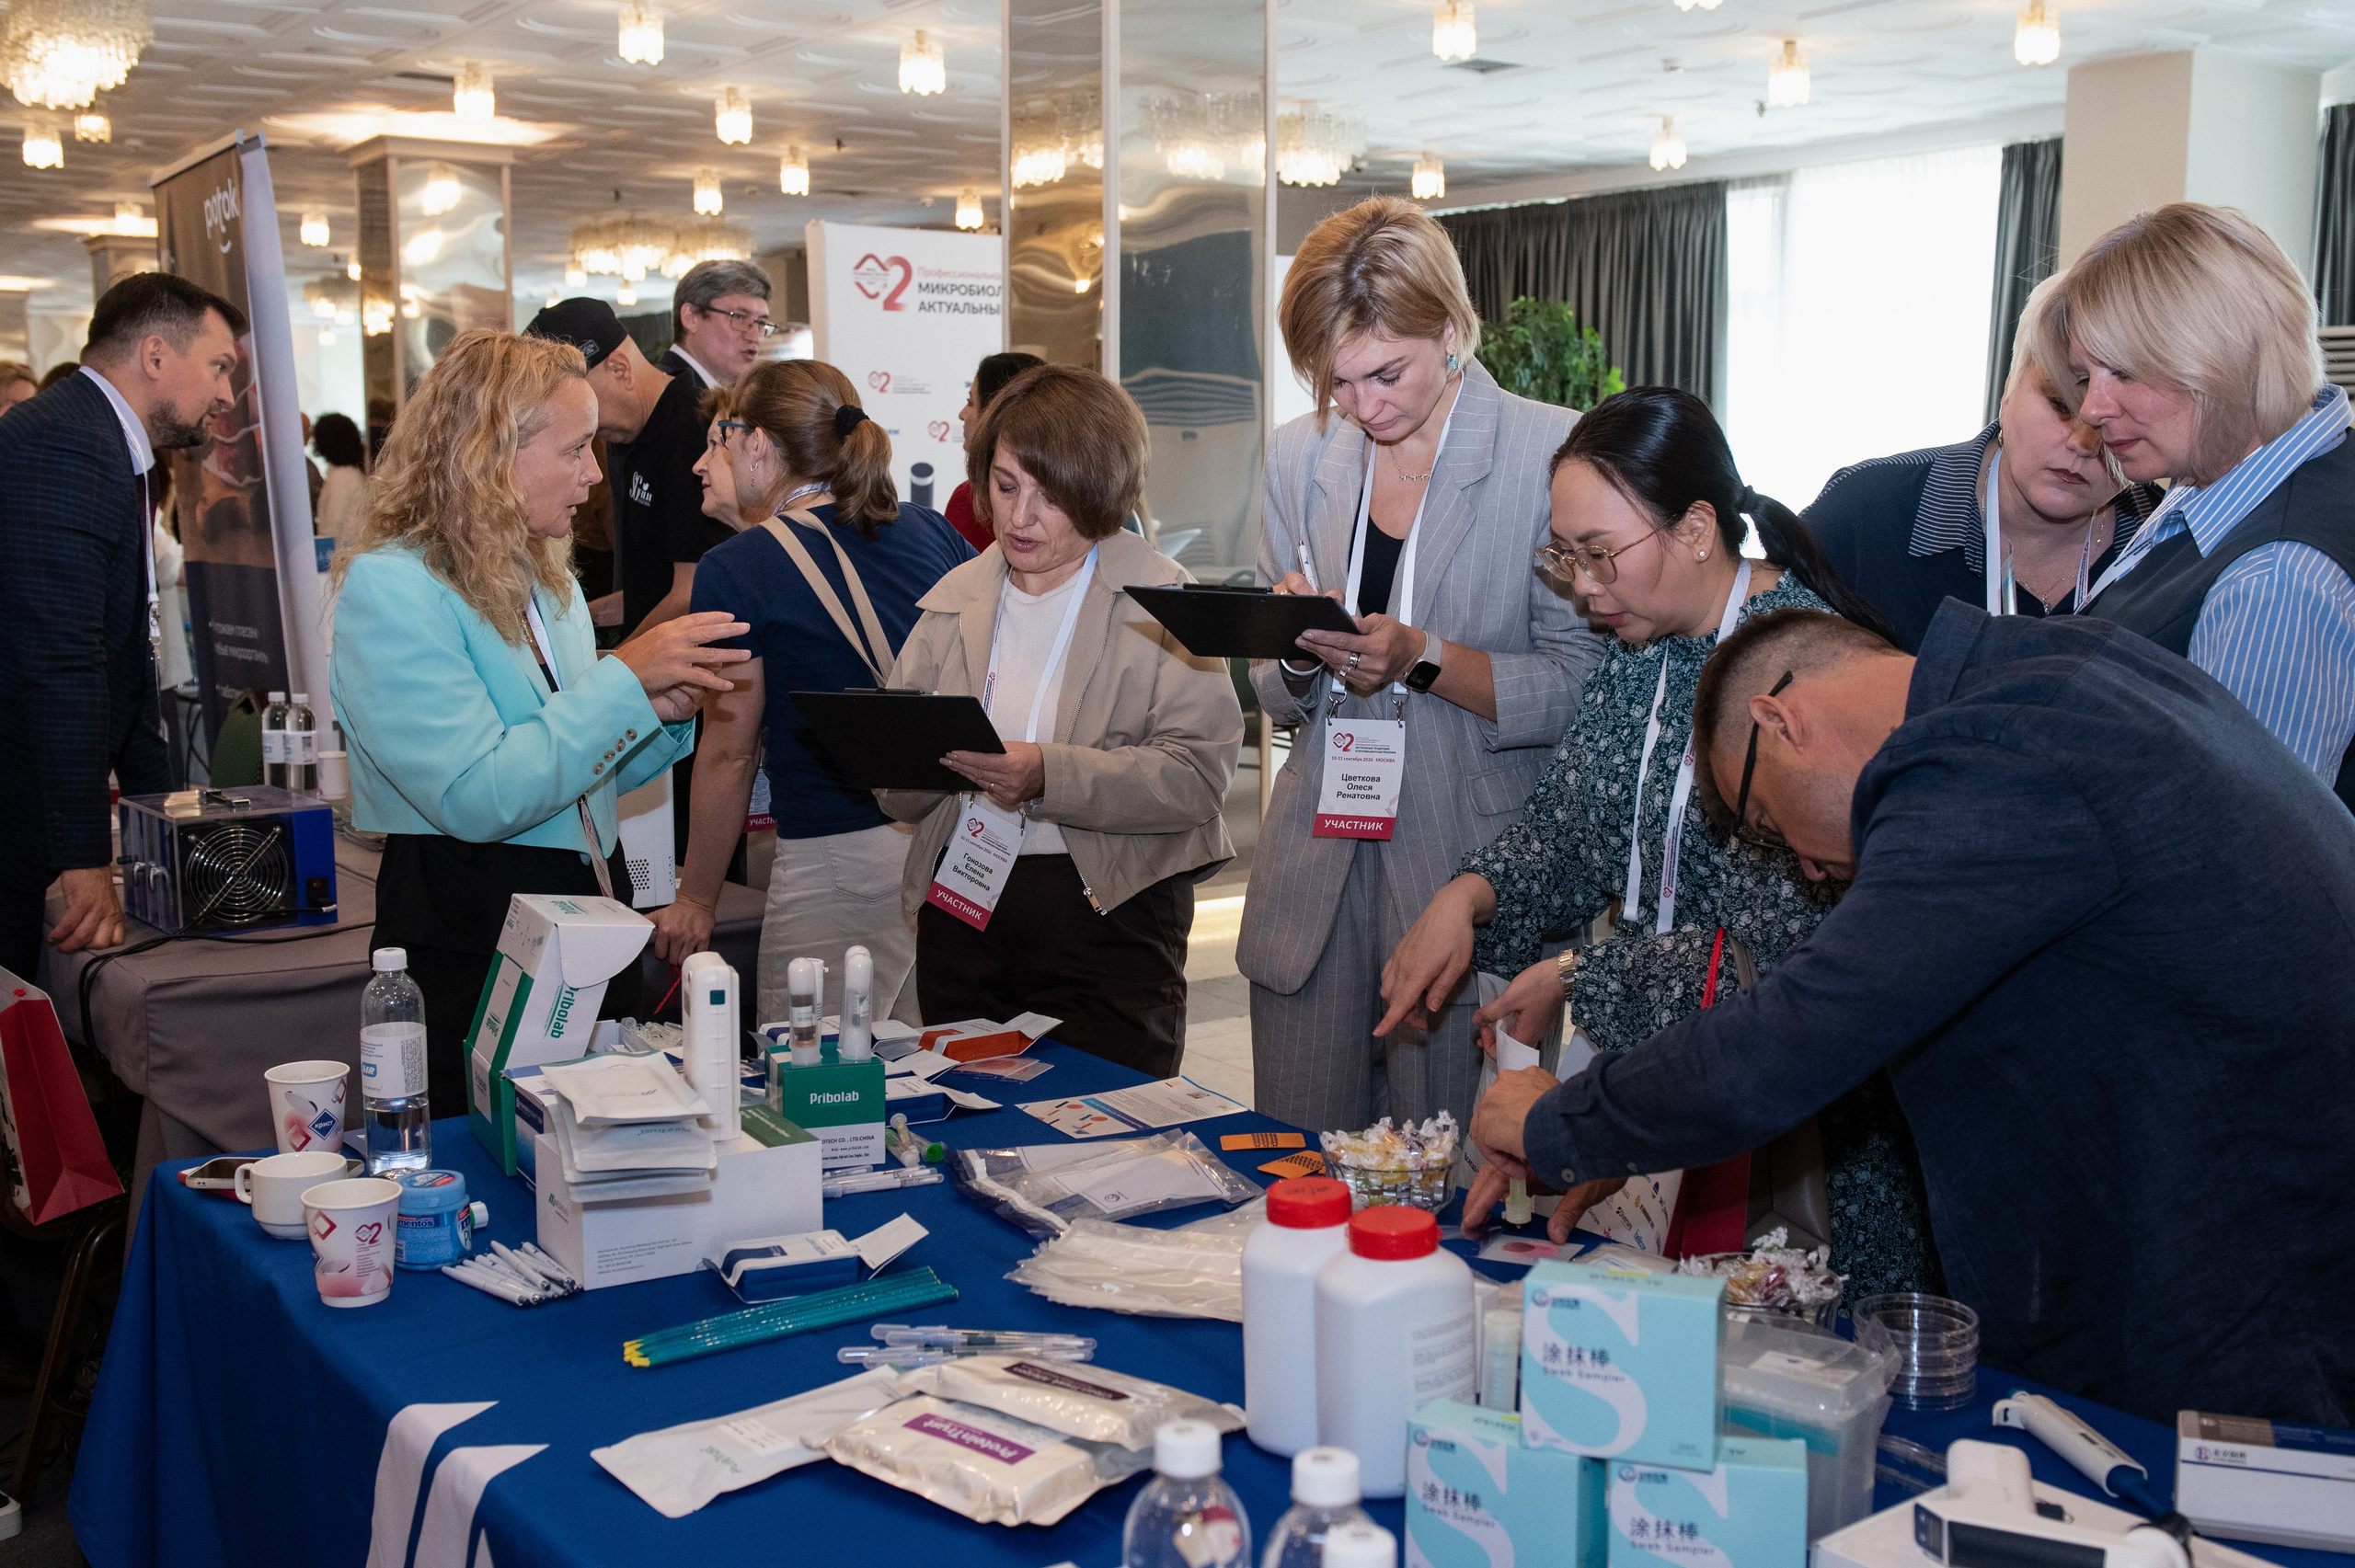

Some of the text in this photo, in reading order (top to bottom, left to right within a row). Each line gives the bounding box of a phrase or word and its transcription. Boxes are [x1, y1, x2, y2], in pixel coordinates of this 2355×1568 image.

[203, 177, 239, 239] potok
[1341, 773, 1381, 783] Цветкова
[1347, 783, 1373, 791] Олеся
[1336, 791, 1381, 800] Ренатовна
[749, 817, 777, 826] УЧАСТН
[1324, 818, 1384, 830] УЧАСТНИК
[964, 863, 985, 878] Елена
[952, 864, 991, 892] Викторовна
[936, 889, 982, 921] УЧАСТНИК
[810, 1091, 859, 1104] Pribolab
[315, 1120, 333, 1129] крист
[397, 1219, 434, 1228] mentos
[1542, 1367, 1573, 1378] Swab
